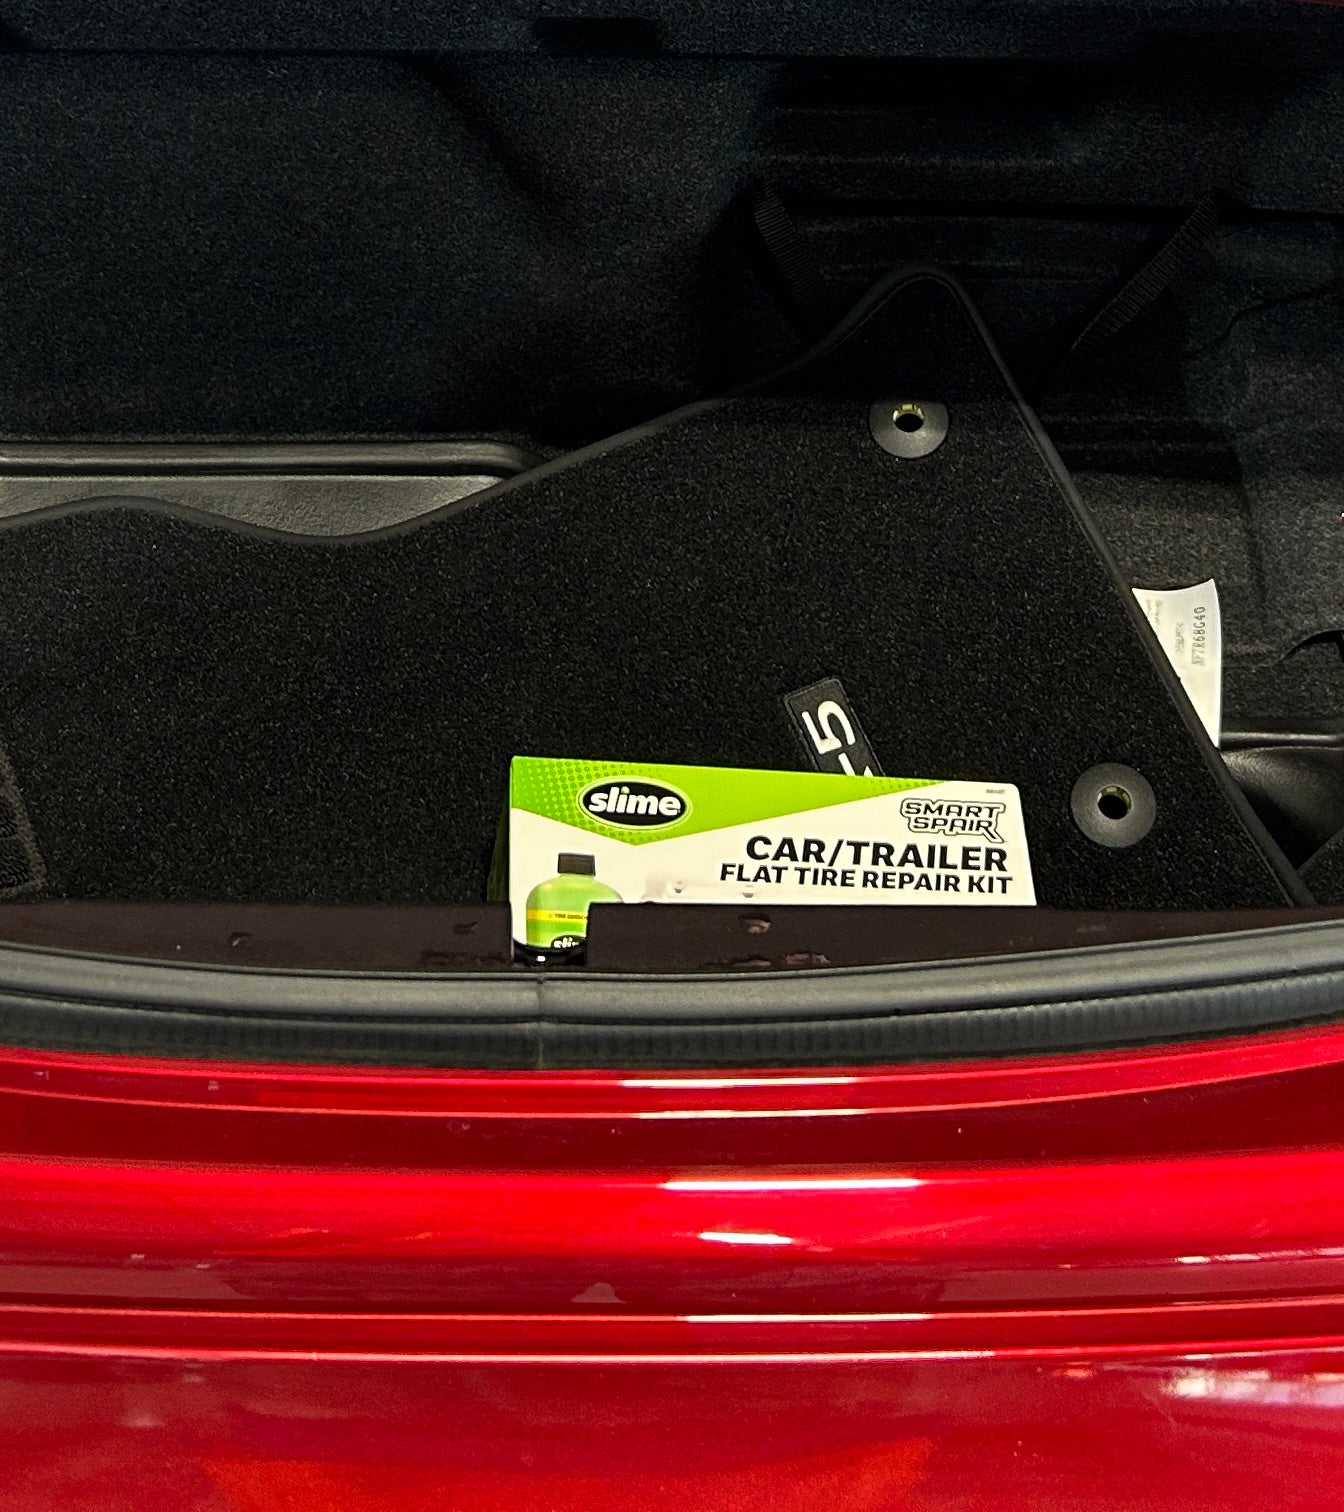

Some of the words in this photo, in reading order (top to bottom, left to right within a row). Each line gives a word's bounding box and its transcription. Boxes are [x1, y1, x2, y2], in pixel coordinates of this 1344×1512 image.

[588, 786, 682, 816] slime
[905, 802, 1001, 819] SMART
[913, 817, 998, 840] SPAIR
[746, 835, 1008, 872] CAR/TRAILER
[720, 863, 789, 884] FLAT
[794, 867, 856, 888] TIRE
[862, 870, 961, 893] REPAIR
[967, 874, 1013, 894] KIT
